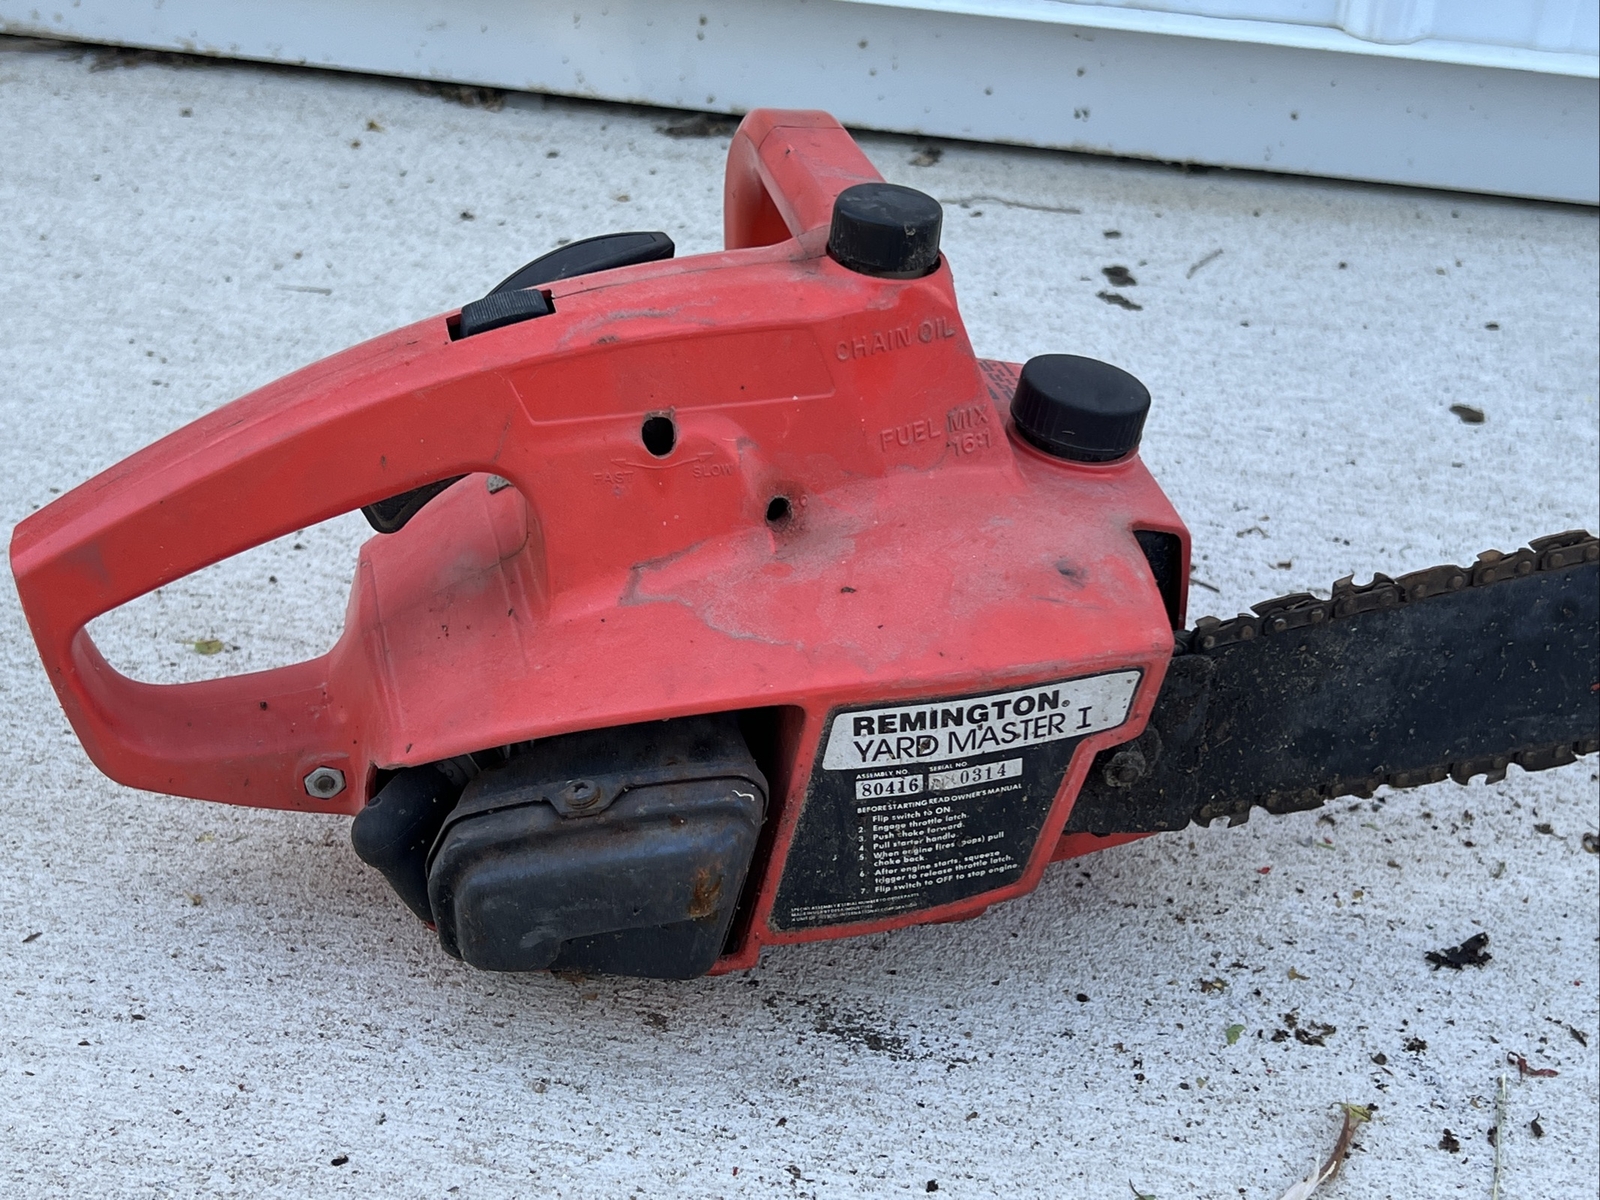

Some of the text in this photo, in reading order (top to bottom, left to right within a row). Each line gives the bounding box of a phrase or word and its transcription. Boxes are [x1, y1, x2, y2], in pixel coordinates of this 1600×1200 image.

[836, 316, 956, 361] CHAIN OIL
[880, 404, 988, 452] FUEL MIX
[951, 428, 991, 456] 16:1
[593, 471, 634, 485] FAST
[692, 464, 734, 478] SLOW
[853, 706, 1092, 762] YARD MASTER I
[856, 771, 893, 780] ASSEMBLY
[929, 764, 953, 772] SERIAL
[862, 778, 919, 797] 80416
[857, 804, 887, 814] BEFORE
[887, 800, 927, 810] STARTING
[929, 795, 950, 805] READ
[988, 783, 1022, 795] MANUAL
[873, 814, 889, 823] Flip
[892, 811, 920, 821] switch
[923, 809, 932, 817] to
[873, 821, 906, 834] Engage
[909, 816, 943, 828] throttle
[873, 829, 894, 841] Push
[873, 841, 890, 850] Pull
[873, 850, 899, 860] When
[987, 831, 1004, 842] pull
[874, 858, 900, 867] choke
[874, 867, 898, 876] After
[901, 862, 931, 874] engine
[964, 851, 1000, 863] squeeze
[908, 872, 917, 880] to
[920, 867, 952, 878] release
[955, 861, 988, 872] throttle
[875, 885, 891, 895] Flip
[893, 882, 922, 891] switch
[924, 879, 933, 887] to
[936, 875, 953, 884] OFF
[956, 873, 965, 881] to
[967, 870, 986, 880] stop
